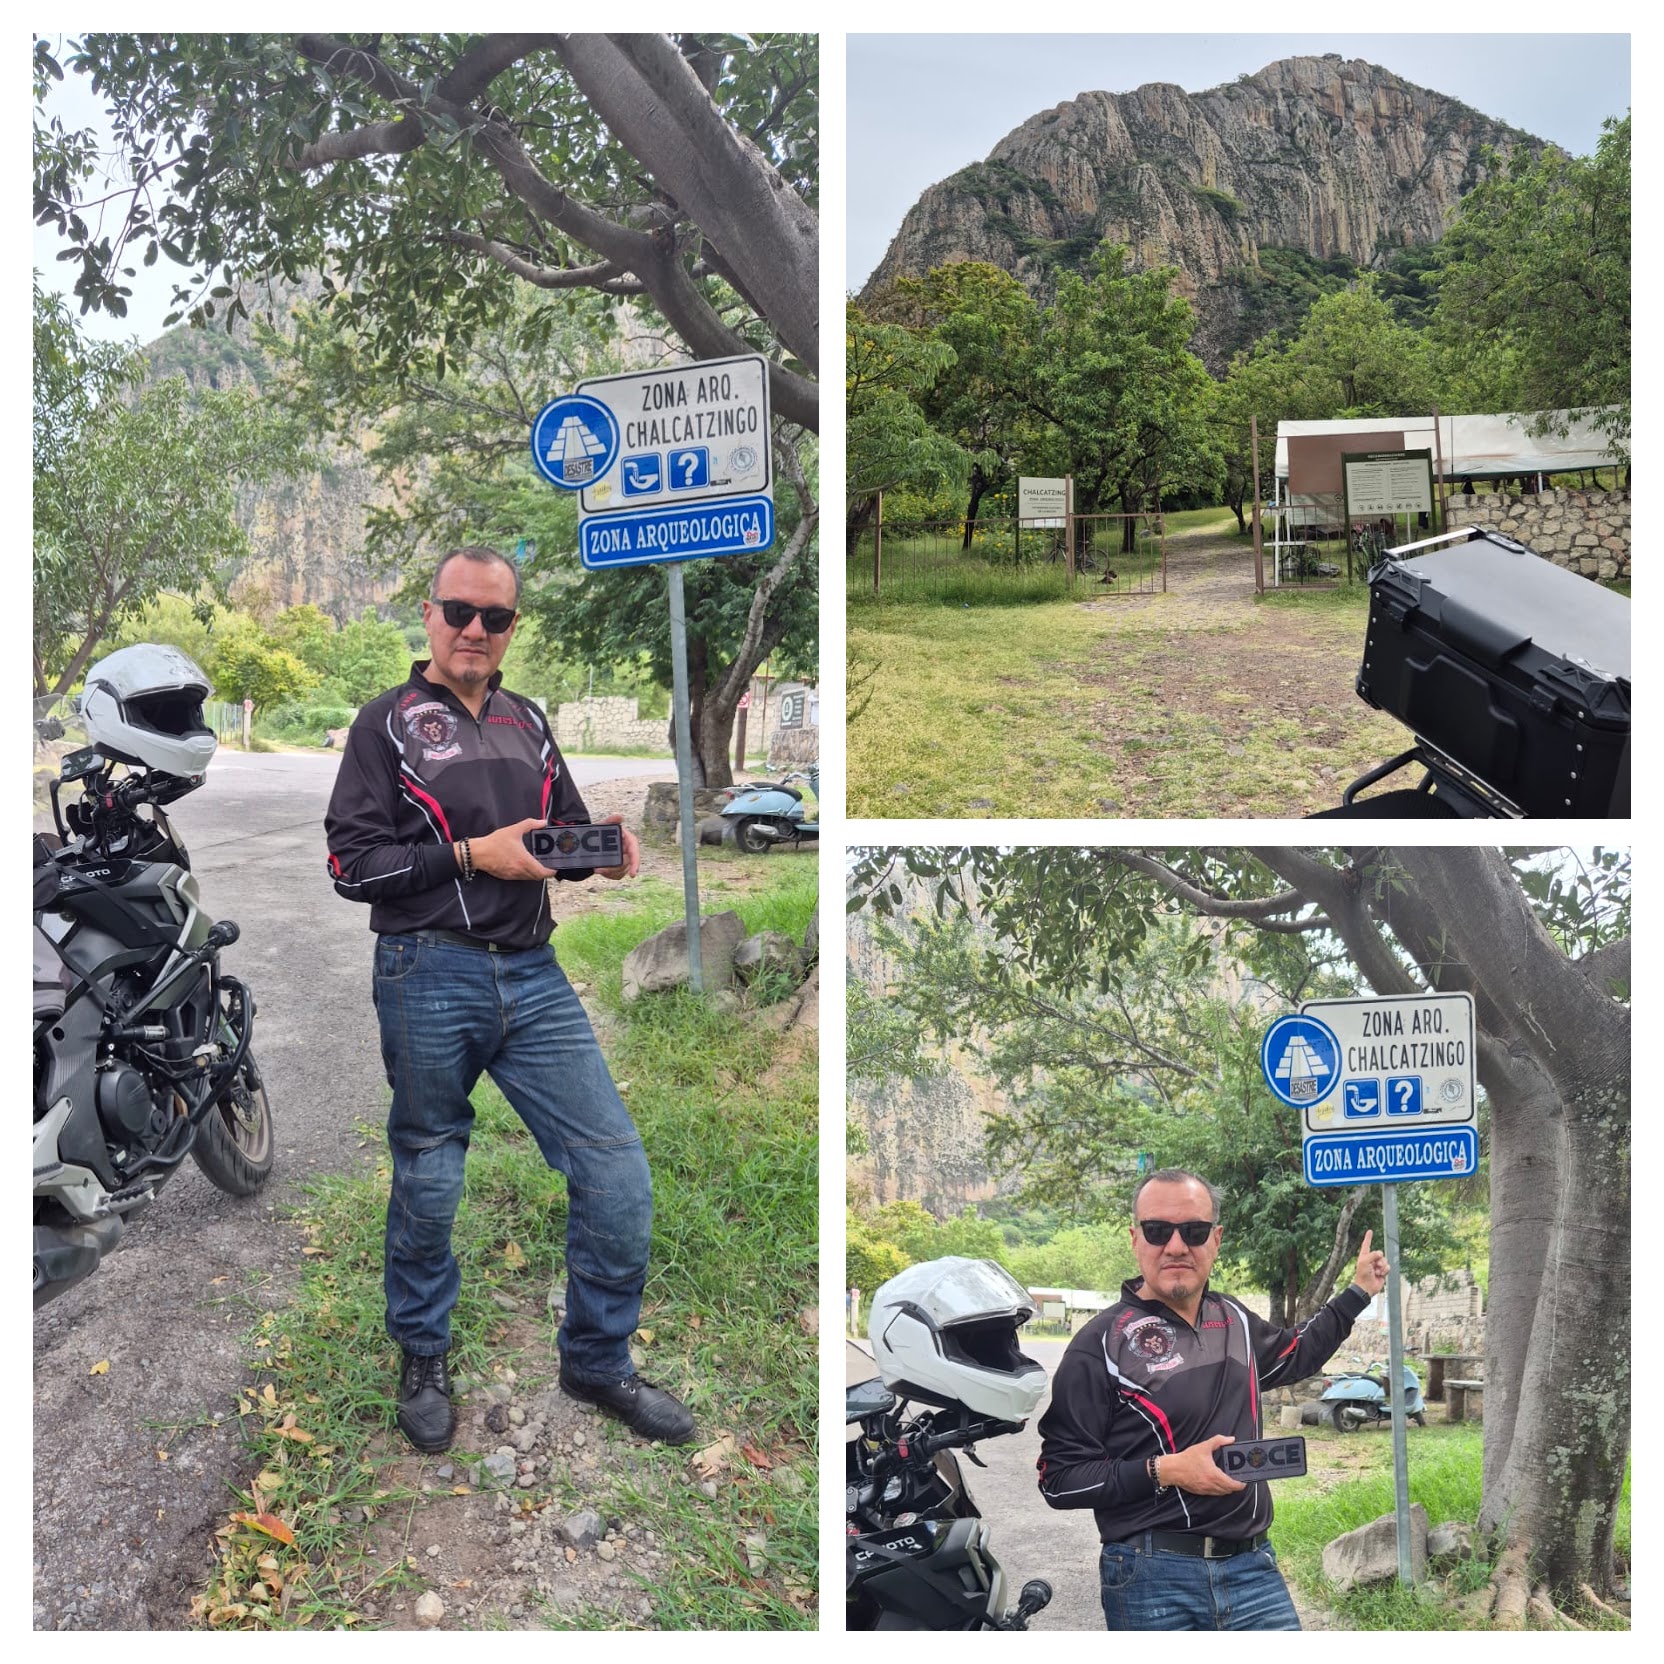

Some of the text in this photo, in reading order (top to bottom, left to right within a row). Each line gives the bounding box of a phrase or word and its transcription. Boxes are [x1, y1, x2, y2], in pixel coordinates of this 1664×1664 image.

[642, 373, 740, 412] ZONA ARQ.
[626, 405, 758, 449] CHALCATZINGO
[1023, 488, 1066, 496] CHALCATZING
[590, 511, 762, 555] ZONA ARQUEOLOGICA
[533, 829, 619, 856] DOCE
[60, 868, 111, 883] CFOTO
[1362, 1008, 1450, 1038] ZONA ARQ.
[1348, 1040, 1465, 1072] CHALCATZINGO
[1314, 1148, 1353, 1172] ZONA
[1356, 1140, 1468, 1173] ARQUEOLOGICA
[1227, 1443, 1300, 1471] DOCE
[855, 1536, 916, 1561] CFOTO
